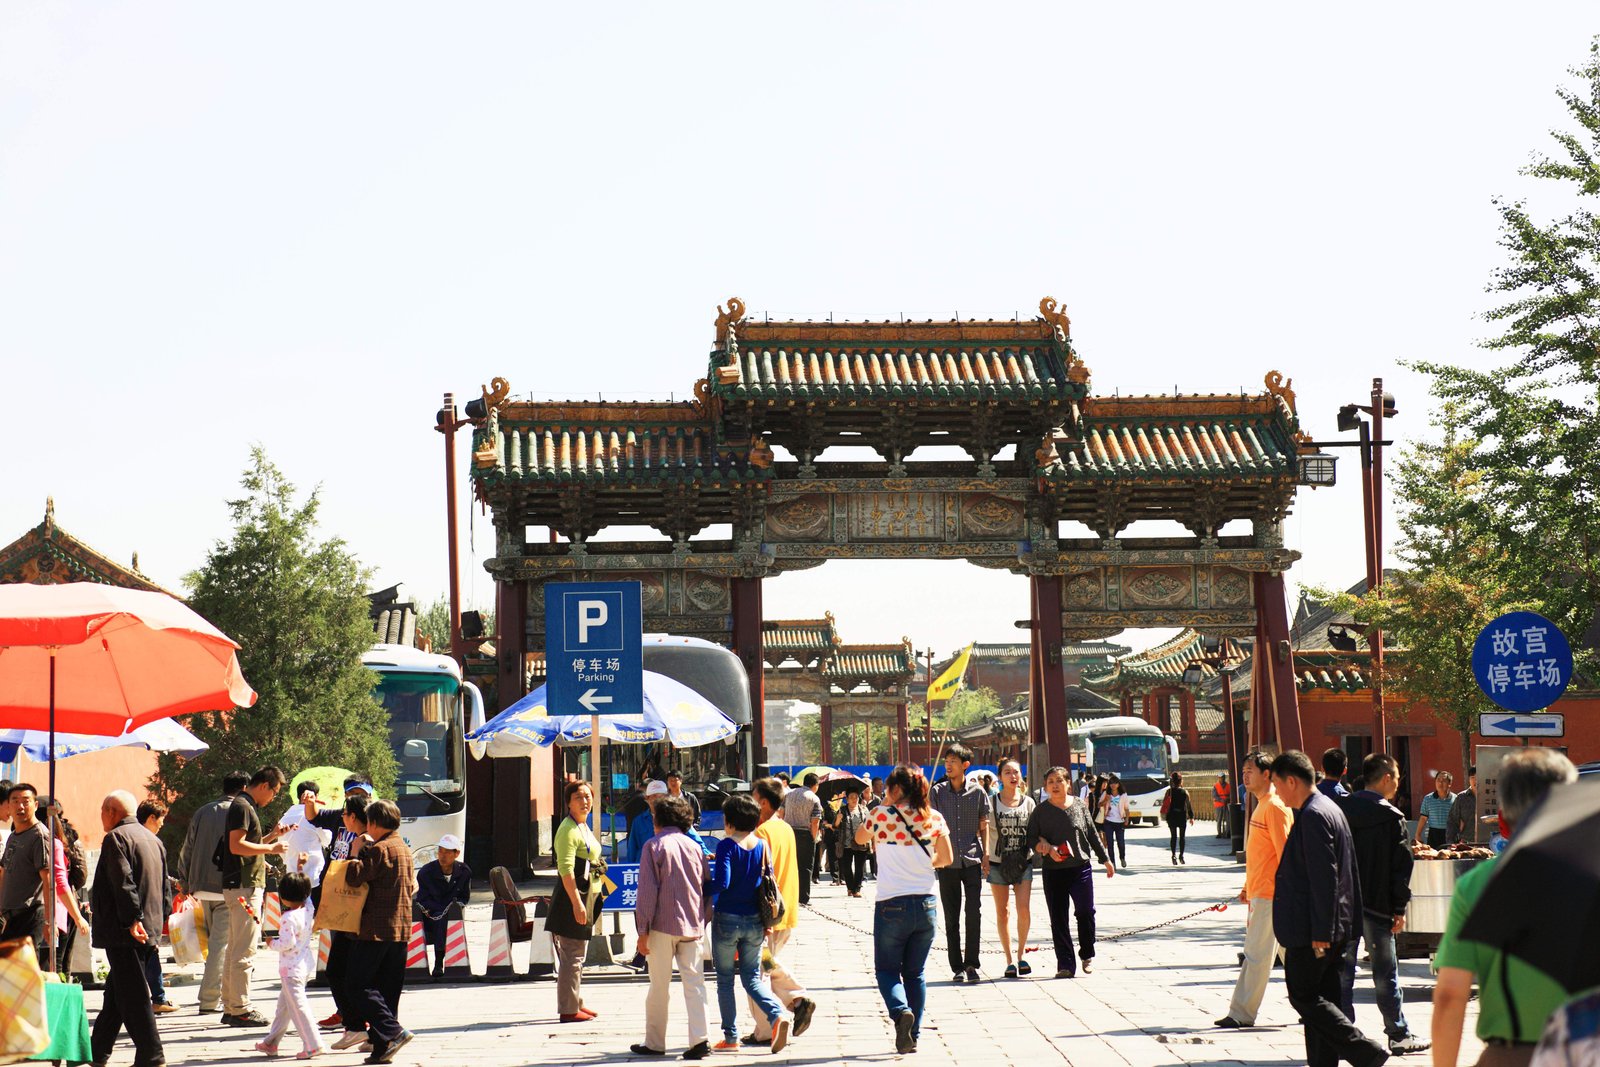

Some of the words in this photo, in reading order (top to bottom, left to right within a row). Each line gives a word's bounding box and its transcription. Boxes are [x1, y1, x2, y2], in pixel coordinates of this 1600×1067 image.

[578, 600, 608, 643] P
[1491, 625, 1548, 657] 故宫
[572, 658, 621, 673] 停车场
[1487, 657, 1561, 694] 停车场
[578, 673, 615, 683] Parking
[1000, 827, 1027, 836] ONLY
